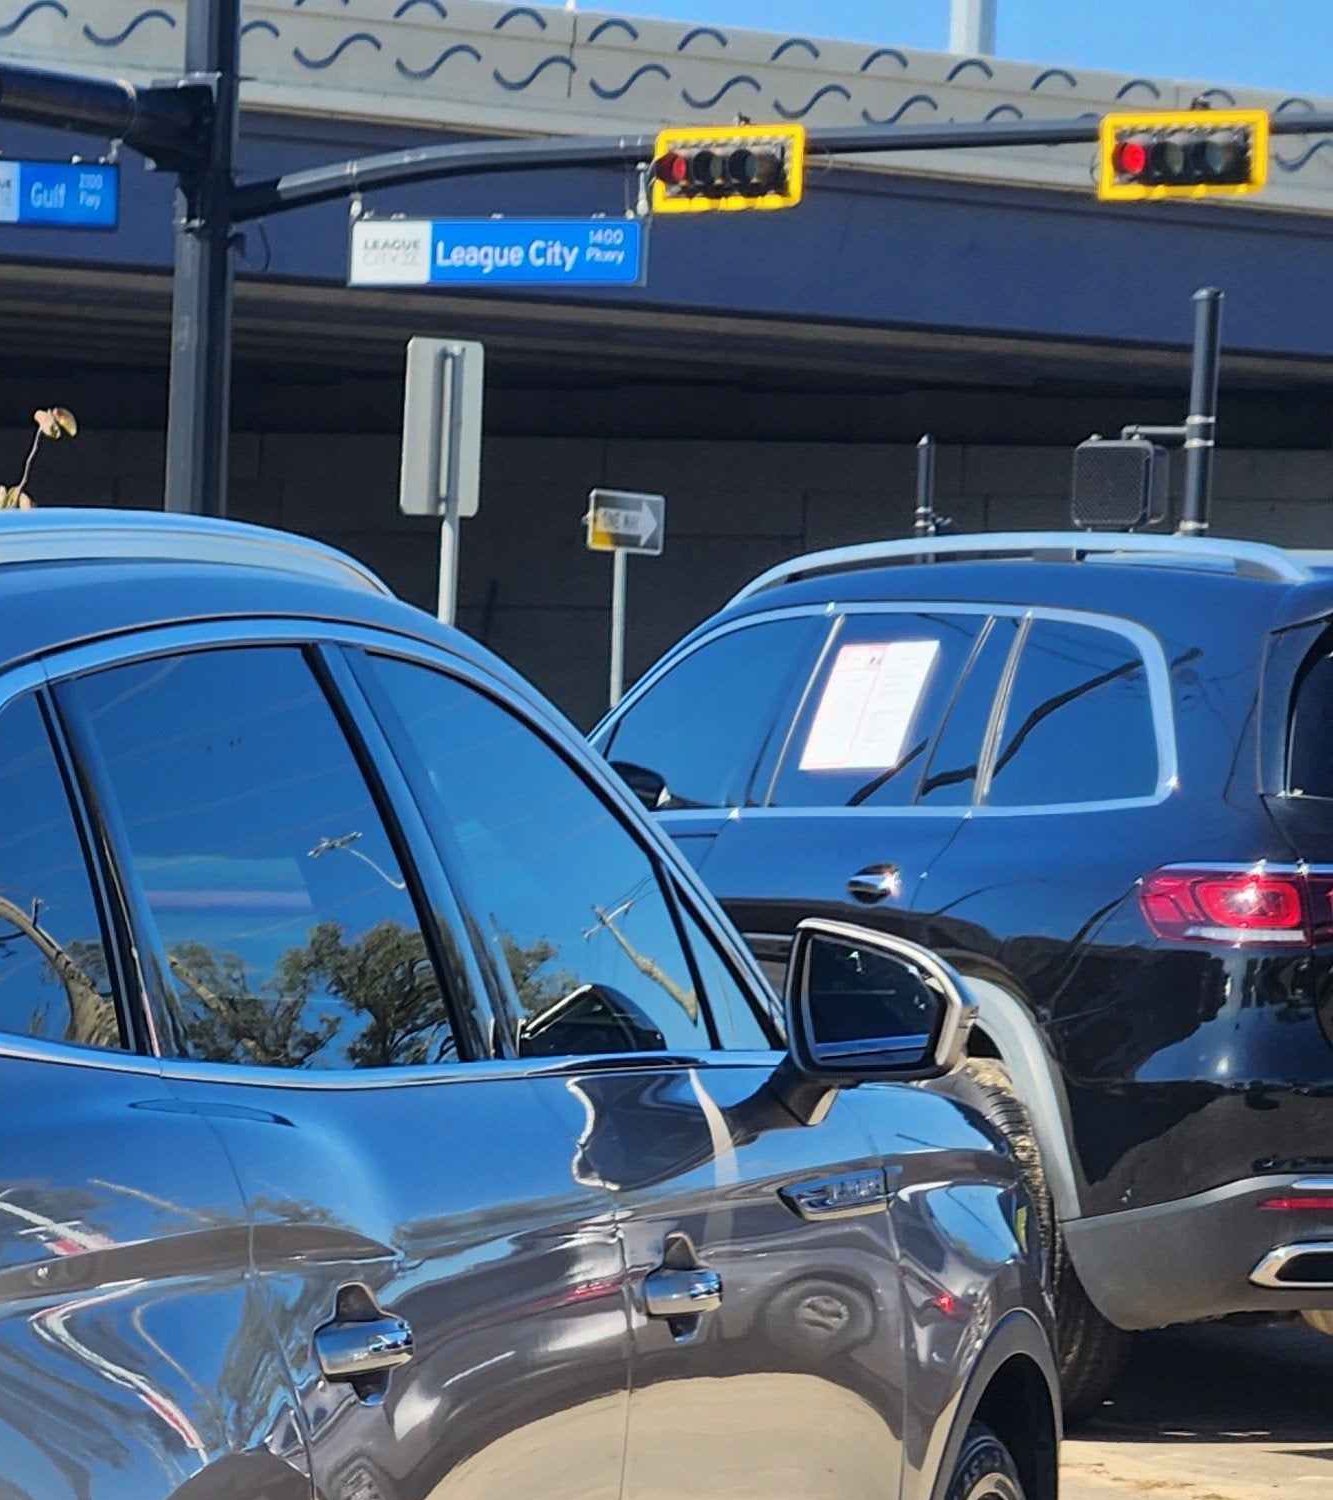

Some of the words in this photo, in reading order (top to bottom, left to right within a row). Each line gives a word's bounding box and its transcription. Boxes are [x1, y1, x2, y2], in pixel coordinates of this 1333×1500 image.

[30, 181, 67, 209] Gulf
[364, 238, 421, 250] LEAGUE
[589, 229, 624, 244] 1400
[436, 240, 524, 274] League
[528, 239, 579, 272] City
[586, 246, 625, 265] Pkwy
